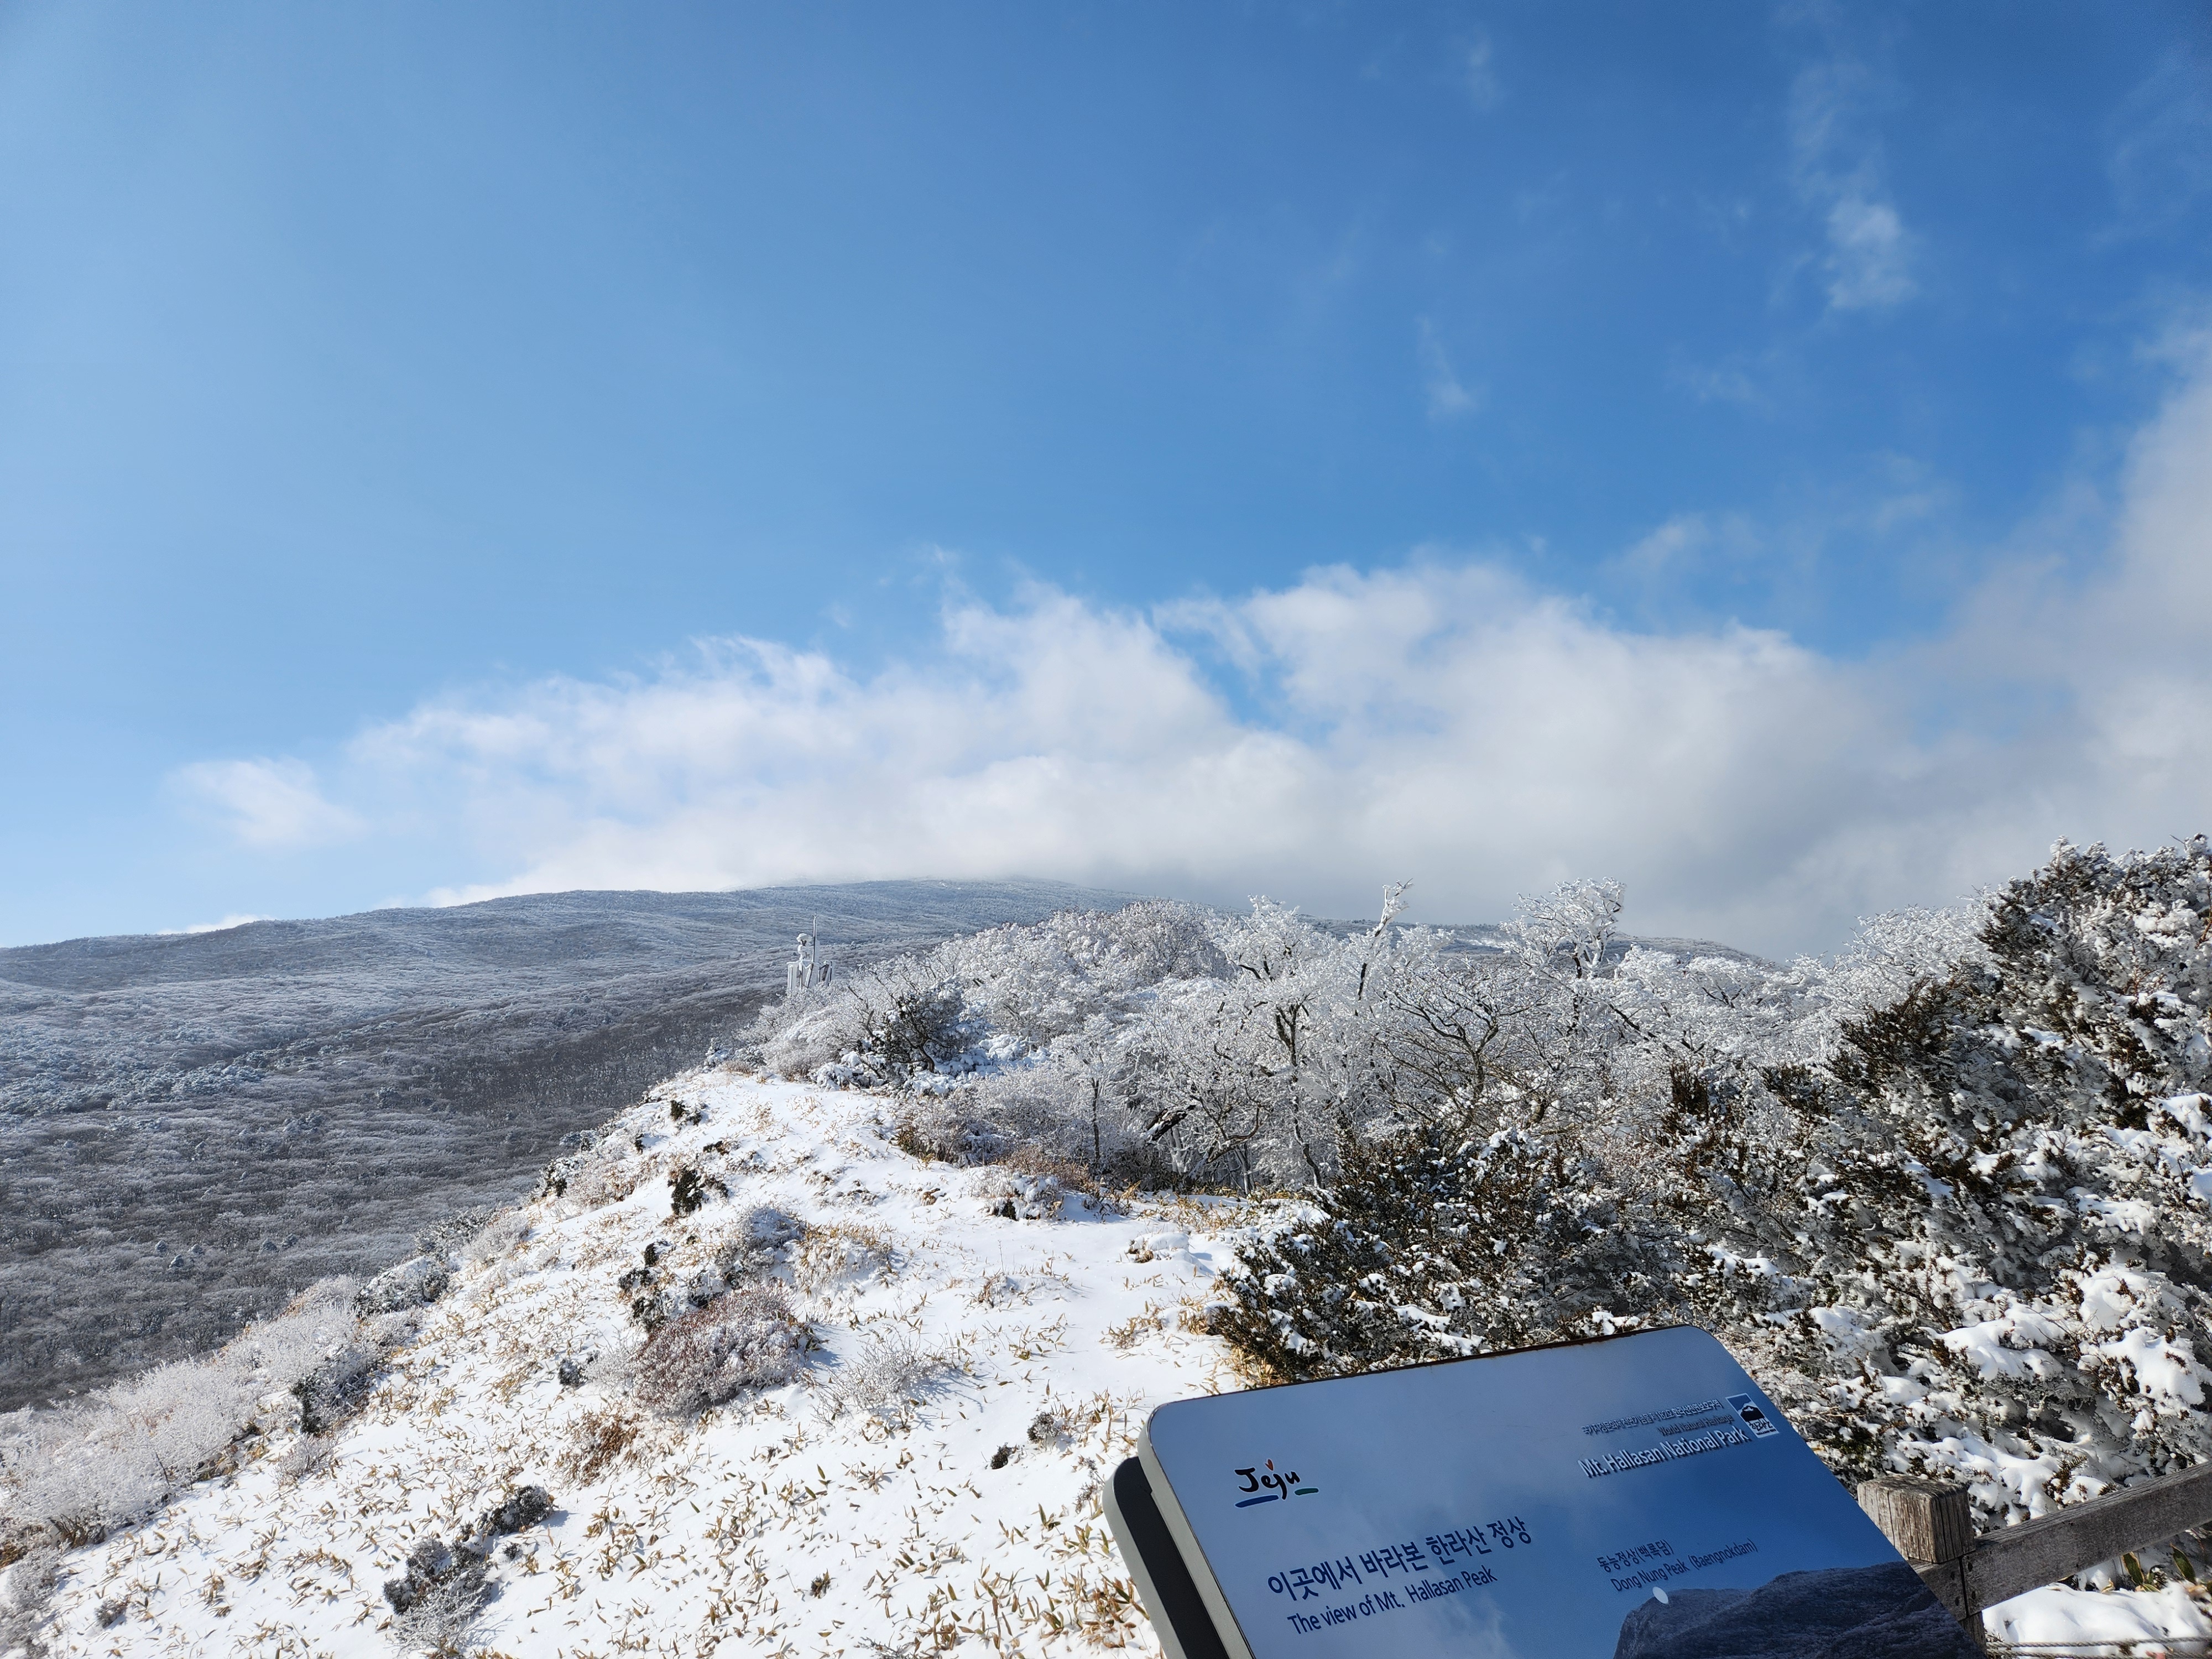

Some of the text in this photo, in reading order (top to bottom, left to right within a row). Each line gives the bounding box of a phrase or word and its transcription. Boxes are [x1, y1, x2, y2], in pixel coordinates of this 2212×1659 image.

[1657, 1414, 1734, 1436] World Natural Heritage
[1577, 1426, 1750, 1477] Mt. Hallasan National Park
[1234, 1459, 1300, 1500] Jeju
[1267, 1516, 1532, 1601] 이곳에서 바라본 한라산 정상
[1597, 1539, 1674, 1573] 동능정상(백록담)
[1610, 1537, 1759, 1592] Dong Nung Peak (Baengnokdam)
[1287, 1564, 1498, 1635] The view of Mt. Hallasan Peak
